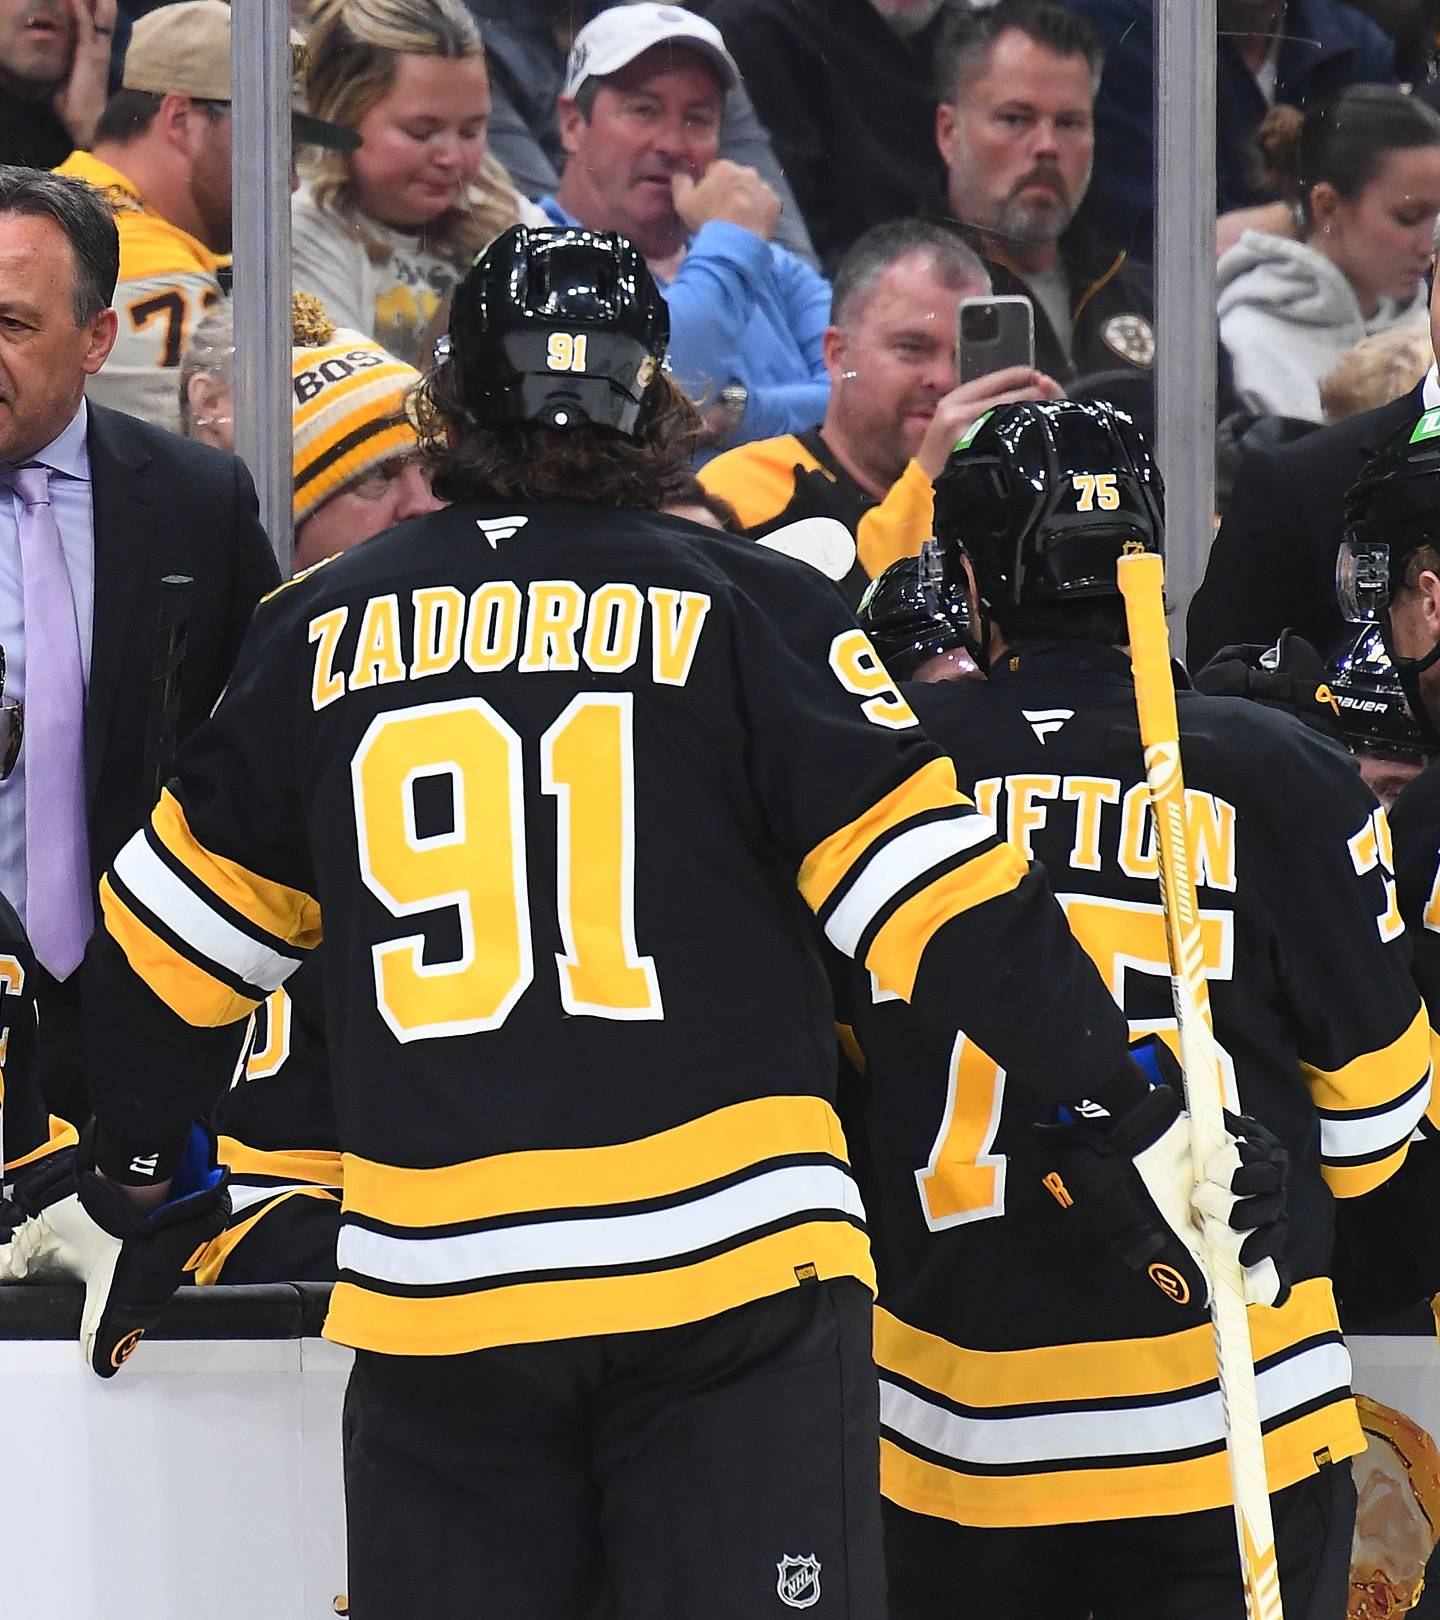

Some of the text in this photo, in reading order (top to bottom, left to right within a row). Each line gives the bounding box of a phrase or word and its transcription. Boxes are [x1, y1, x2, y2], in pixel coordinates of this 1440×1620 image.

[125, 285, 222, 368] 7
[546, 332, 588, 373] 91
[1071, 473, 1121, 512] 75
[308, 579, 712, 712] ZADOROV
[351, 692, 664, 1043] 91
[1166, 800, 1195, 926] WARRIOR
[787, 1567, 814, 1600] NHL
